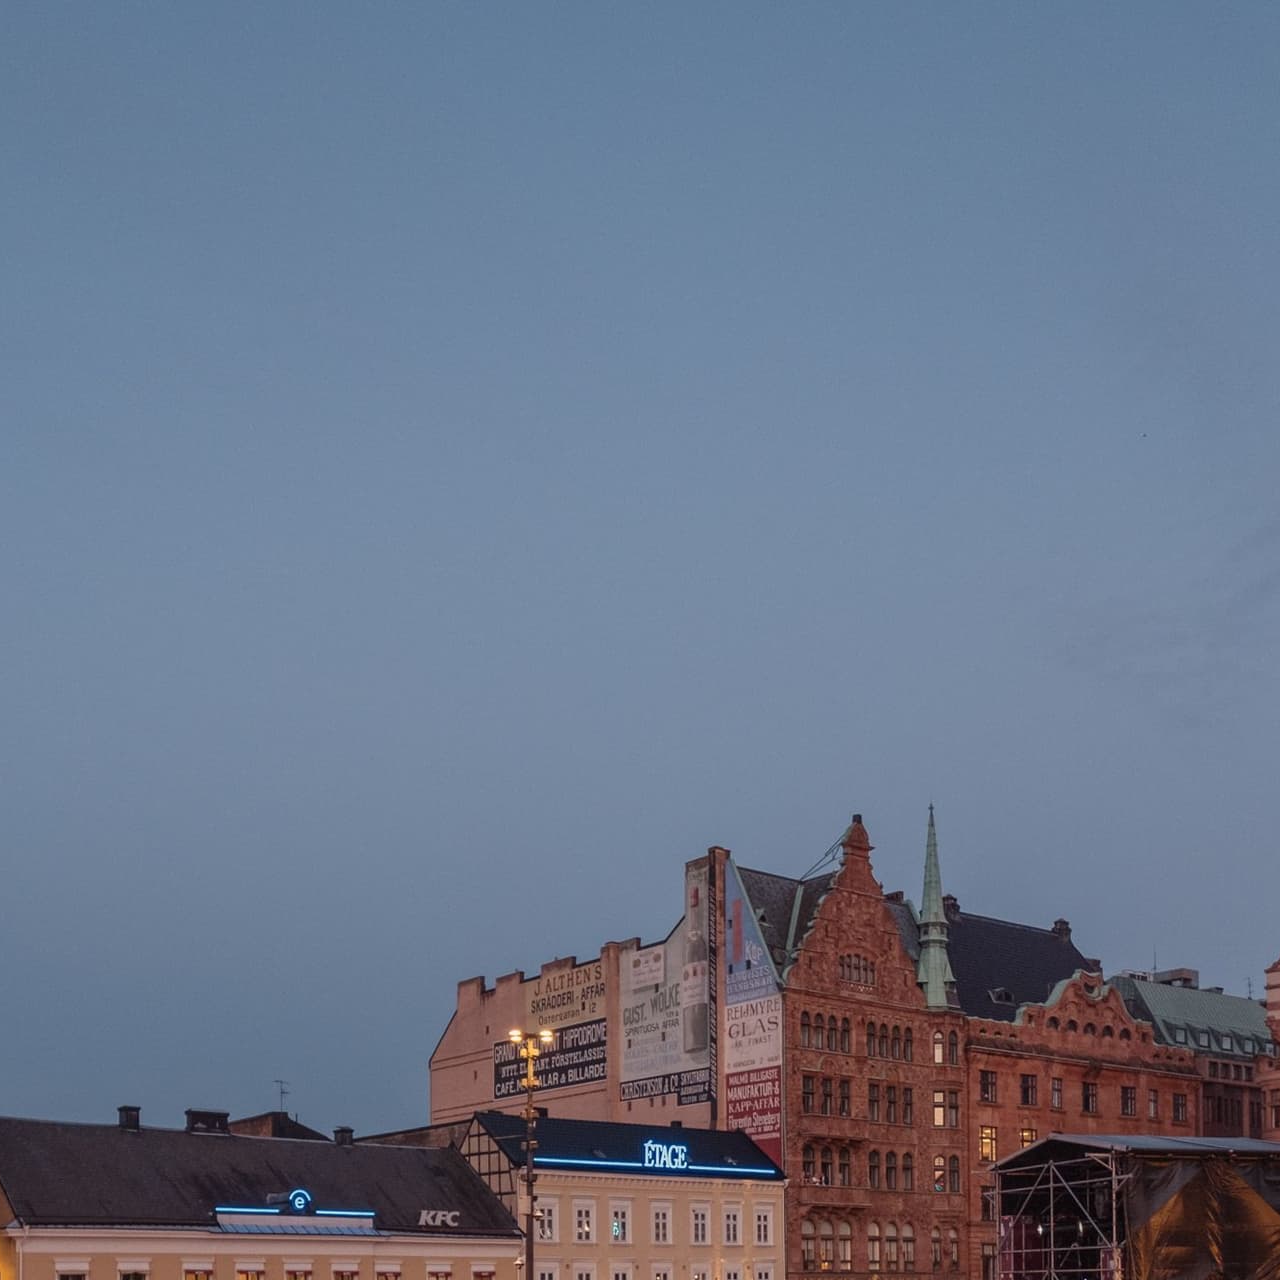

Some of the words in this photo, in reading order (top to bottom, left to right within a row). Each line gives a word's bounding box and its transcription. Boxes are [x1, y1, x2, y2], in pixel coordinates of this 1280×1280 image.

[623, 1003, 648, 1026] GUST.
[728, 1015, 779, 1039] GLAS
[494, 1043, 516, 1064] GRAND
[643, 1139, 688, 1169] ÉTAGE
[419, 1210, 461, 1227] KFC
